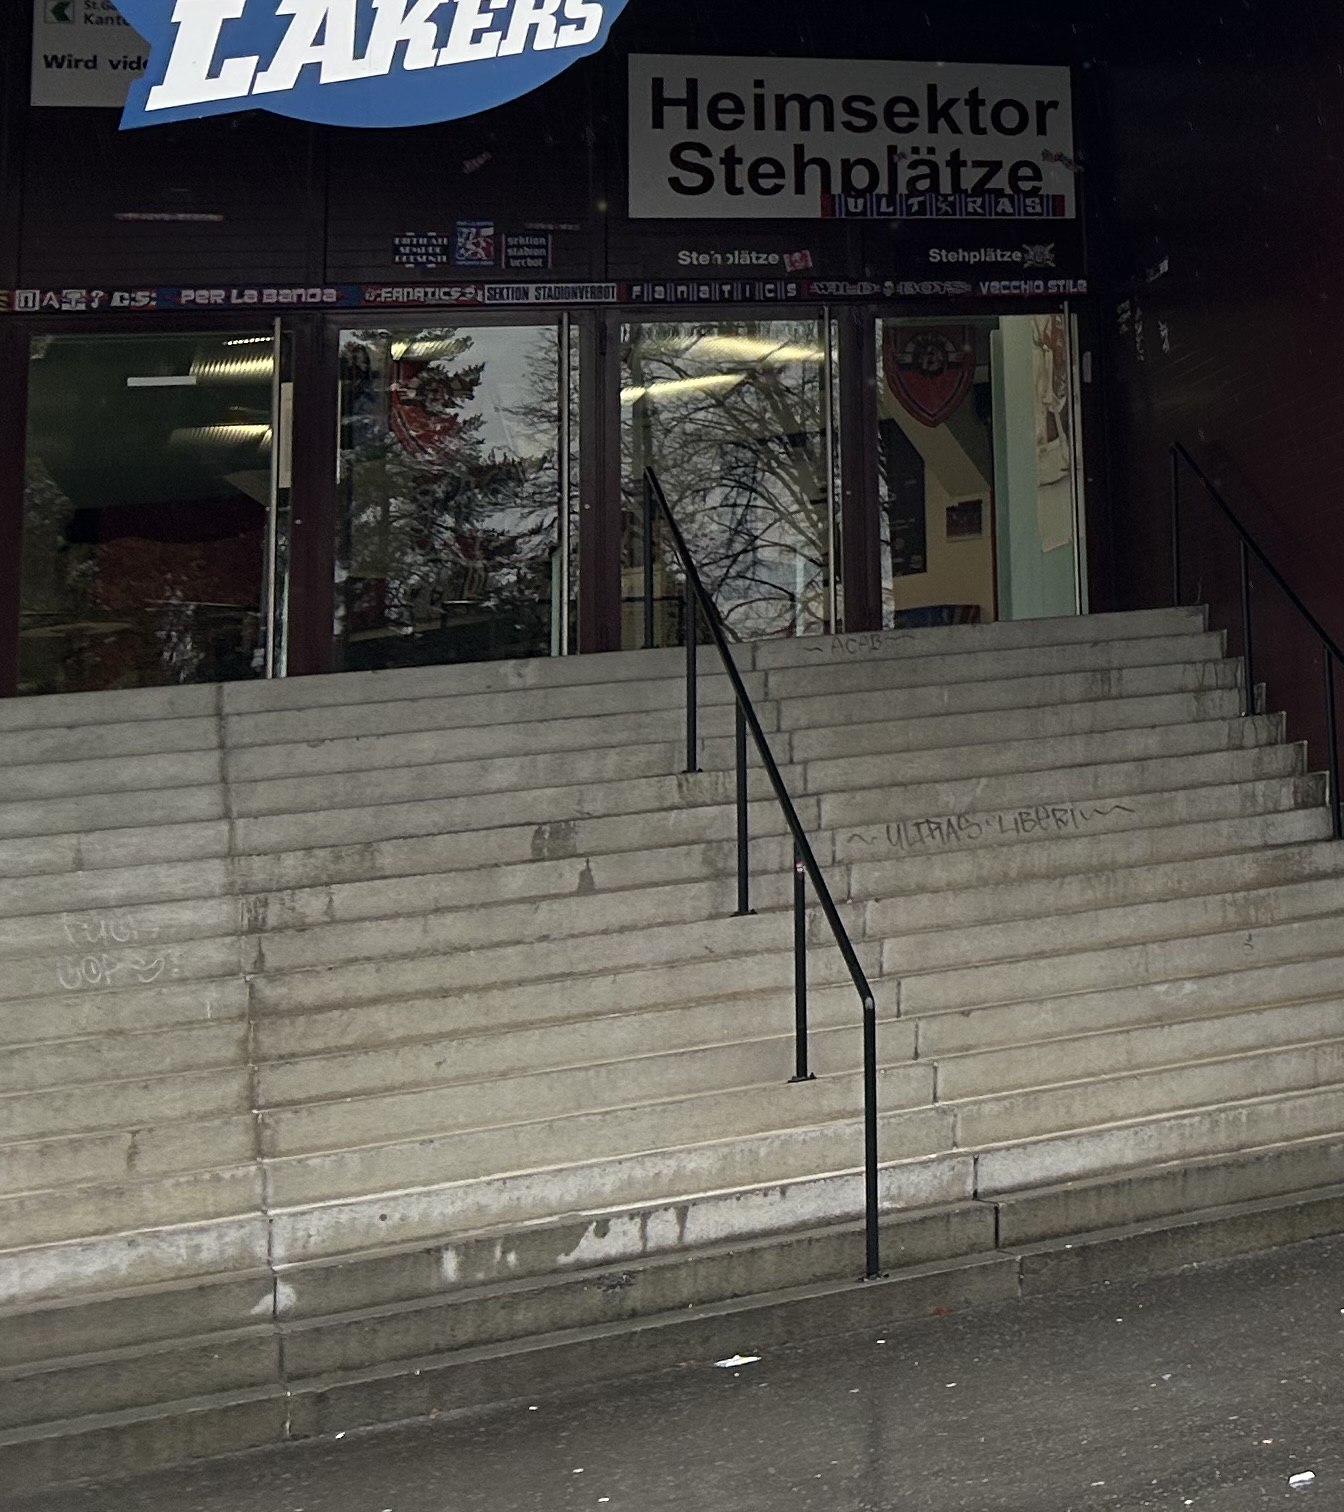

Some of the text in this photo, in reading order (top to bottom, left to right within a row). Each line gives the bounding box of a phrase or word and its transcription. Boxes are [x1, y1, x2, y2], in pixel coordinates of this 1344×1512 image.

[43, 53, 98, 70] Wird
[650, 76, 1060, 137] Heimsektor
[666, 140, 1044, 196] Stehplätze
[927, 247, 1023, 265] Stehplätze
[487, 287, 529, 300] SEKTION
